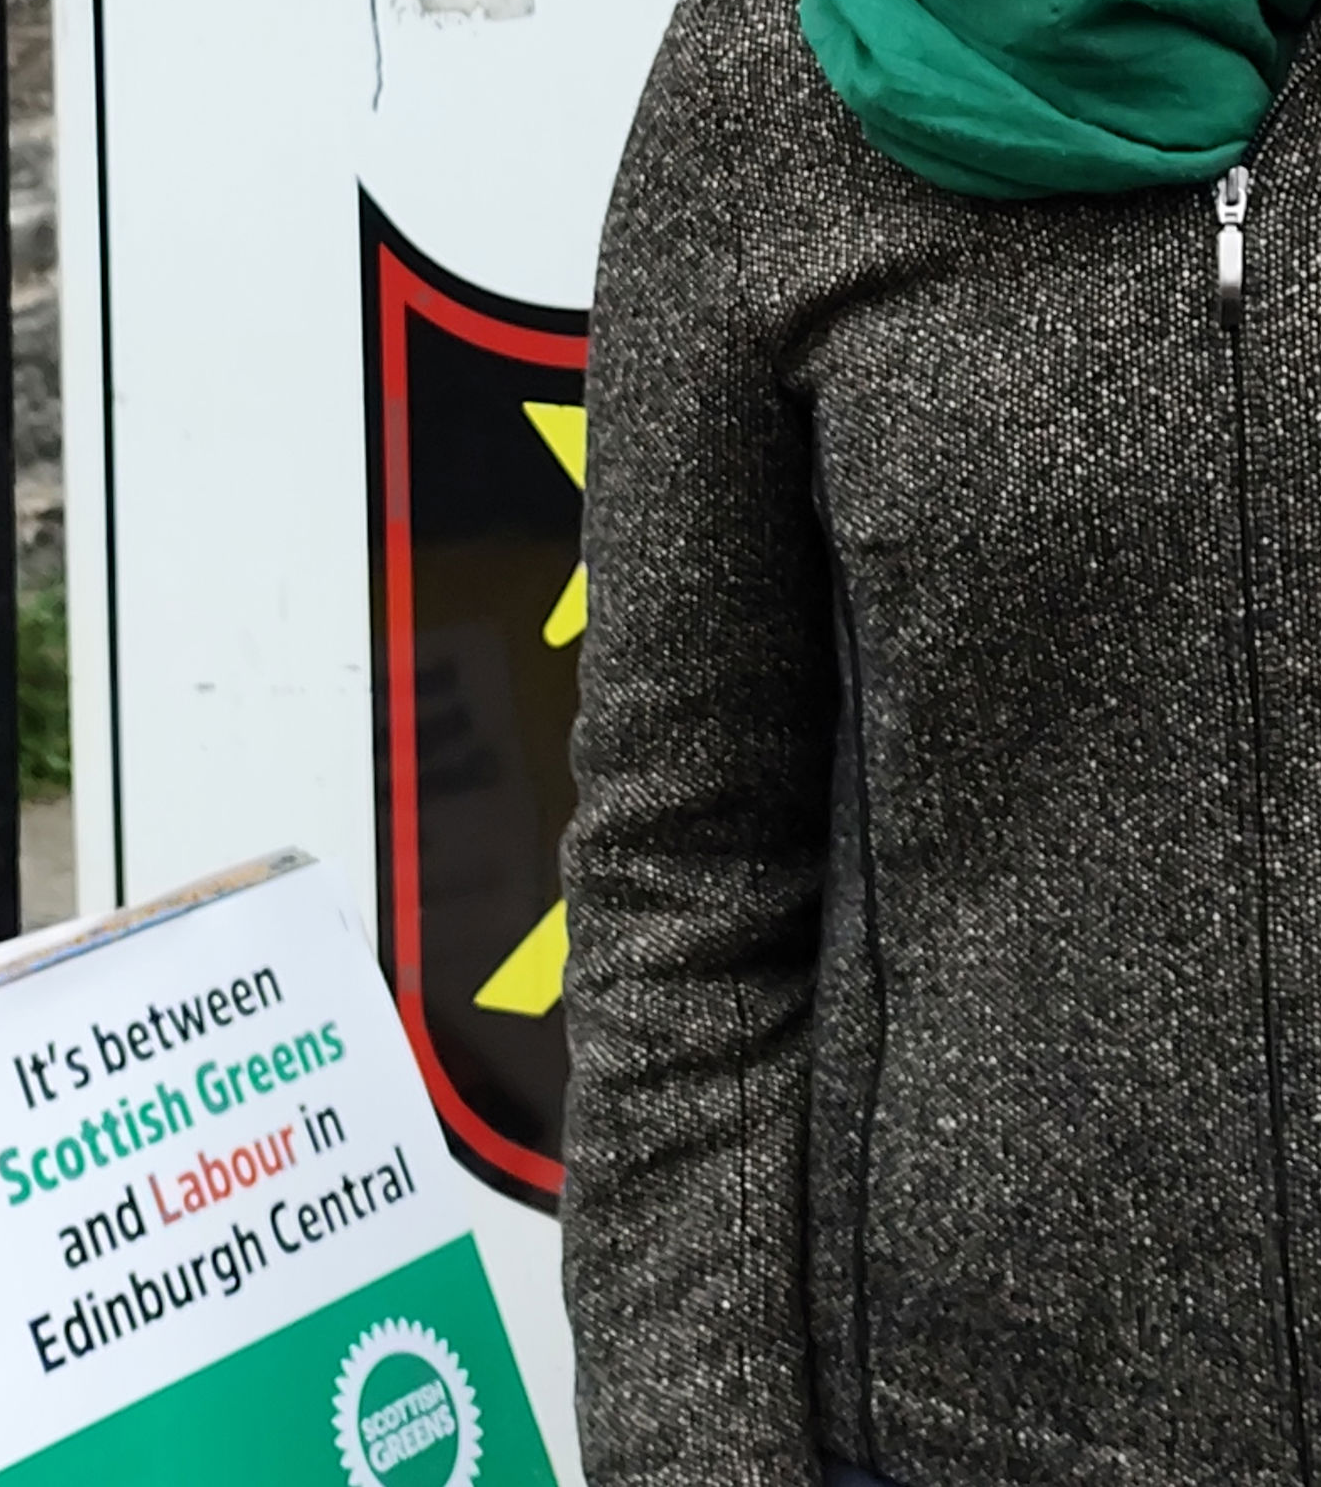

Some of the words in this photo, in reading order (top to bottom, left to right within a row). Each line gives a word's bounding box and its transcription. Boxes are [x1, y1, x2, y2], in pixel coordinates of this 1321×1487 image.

[14, 1042, 91, 1110] It's
[92, 967, 285, 1077] between
[196, 1020, 346, 1115] Greens
[58, 1186, 149, 1269] and
[147, 1124, 300, 1226] Labour
[300, 1103, 345, 1155] in
[28, 1226, 267, 1374] Edinburgh
[270, 1145, 417, 1269] Central
[361, 1380, 446, 1442] SCOTTISH
[369, 1404, 455, 1473] GREENS
